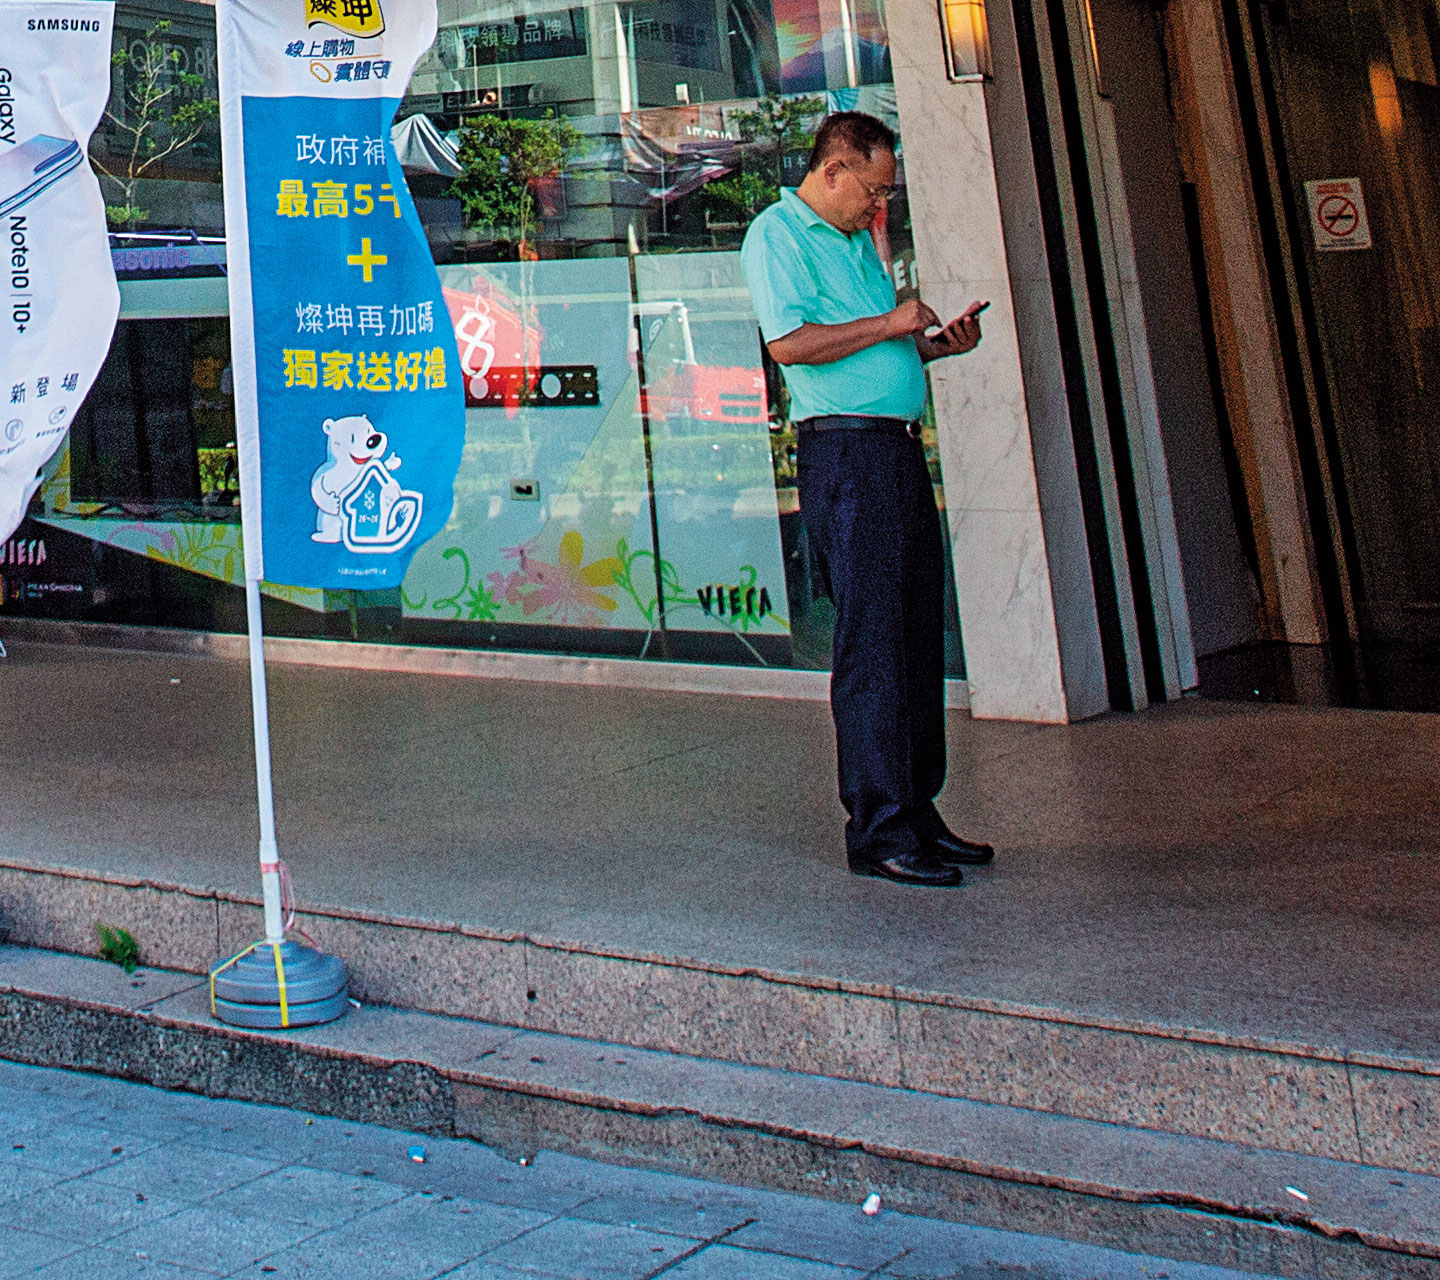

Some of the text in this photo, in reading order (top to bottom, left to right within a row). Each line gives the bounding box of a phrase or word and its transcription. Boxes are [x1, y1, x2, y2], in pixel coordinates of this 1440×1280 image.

[26, 18, 101, 33] SAMSUNG
[285, 39, 355, 59] 線上購物
[296, 133, 386, 167] 政府補
[112, 243, 191, 271] asonic
[9, 215, 32, 335] Note10 10+
[296, 301, 435, 338] 燦坤再加碼
[282, 346, 448, 393] 獨家送好禮
